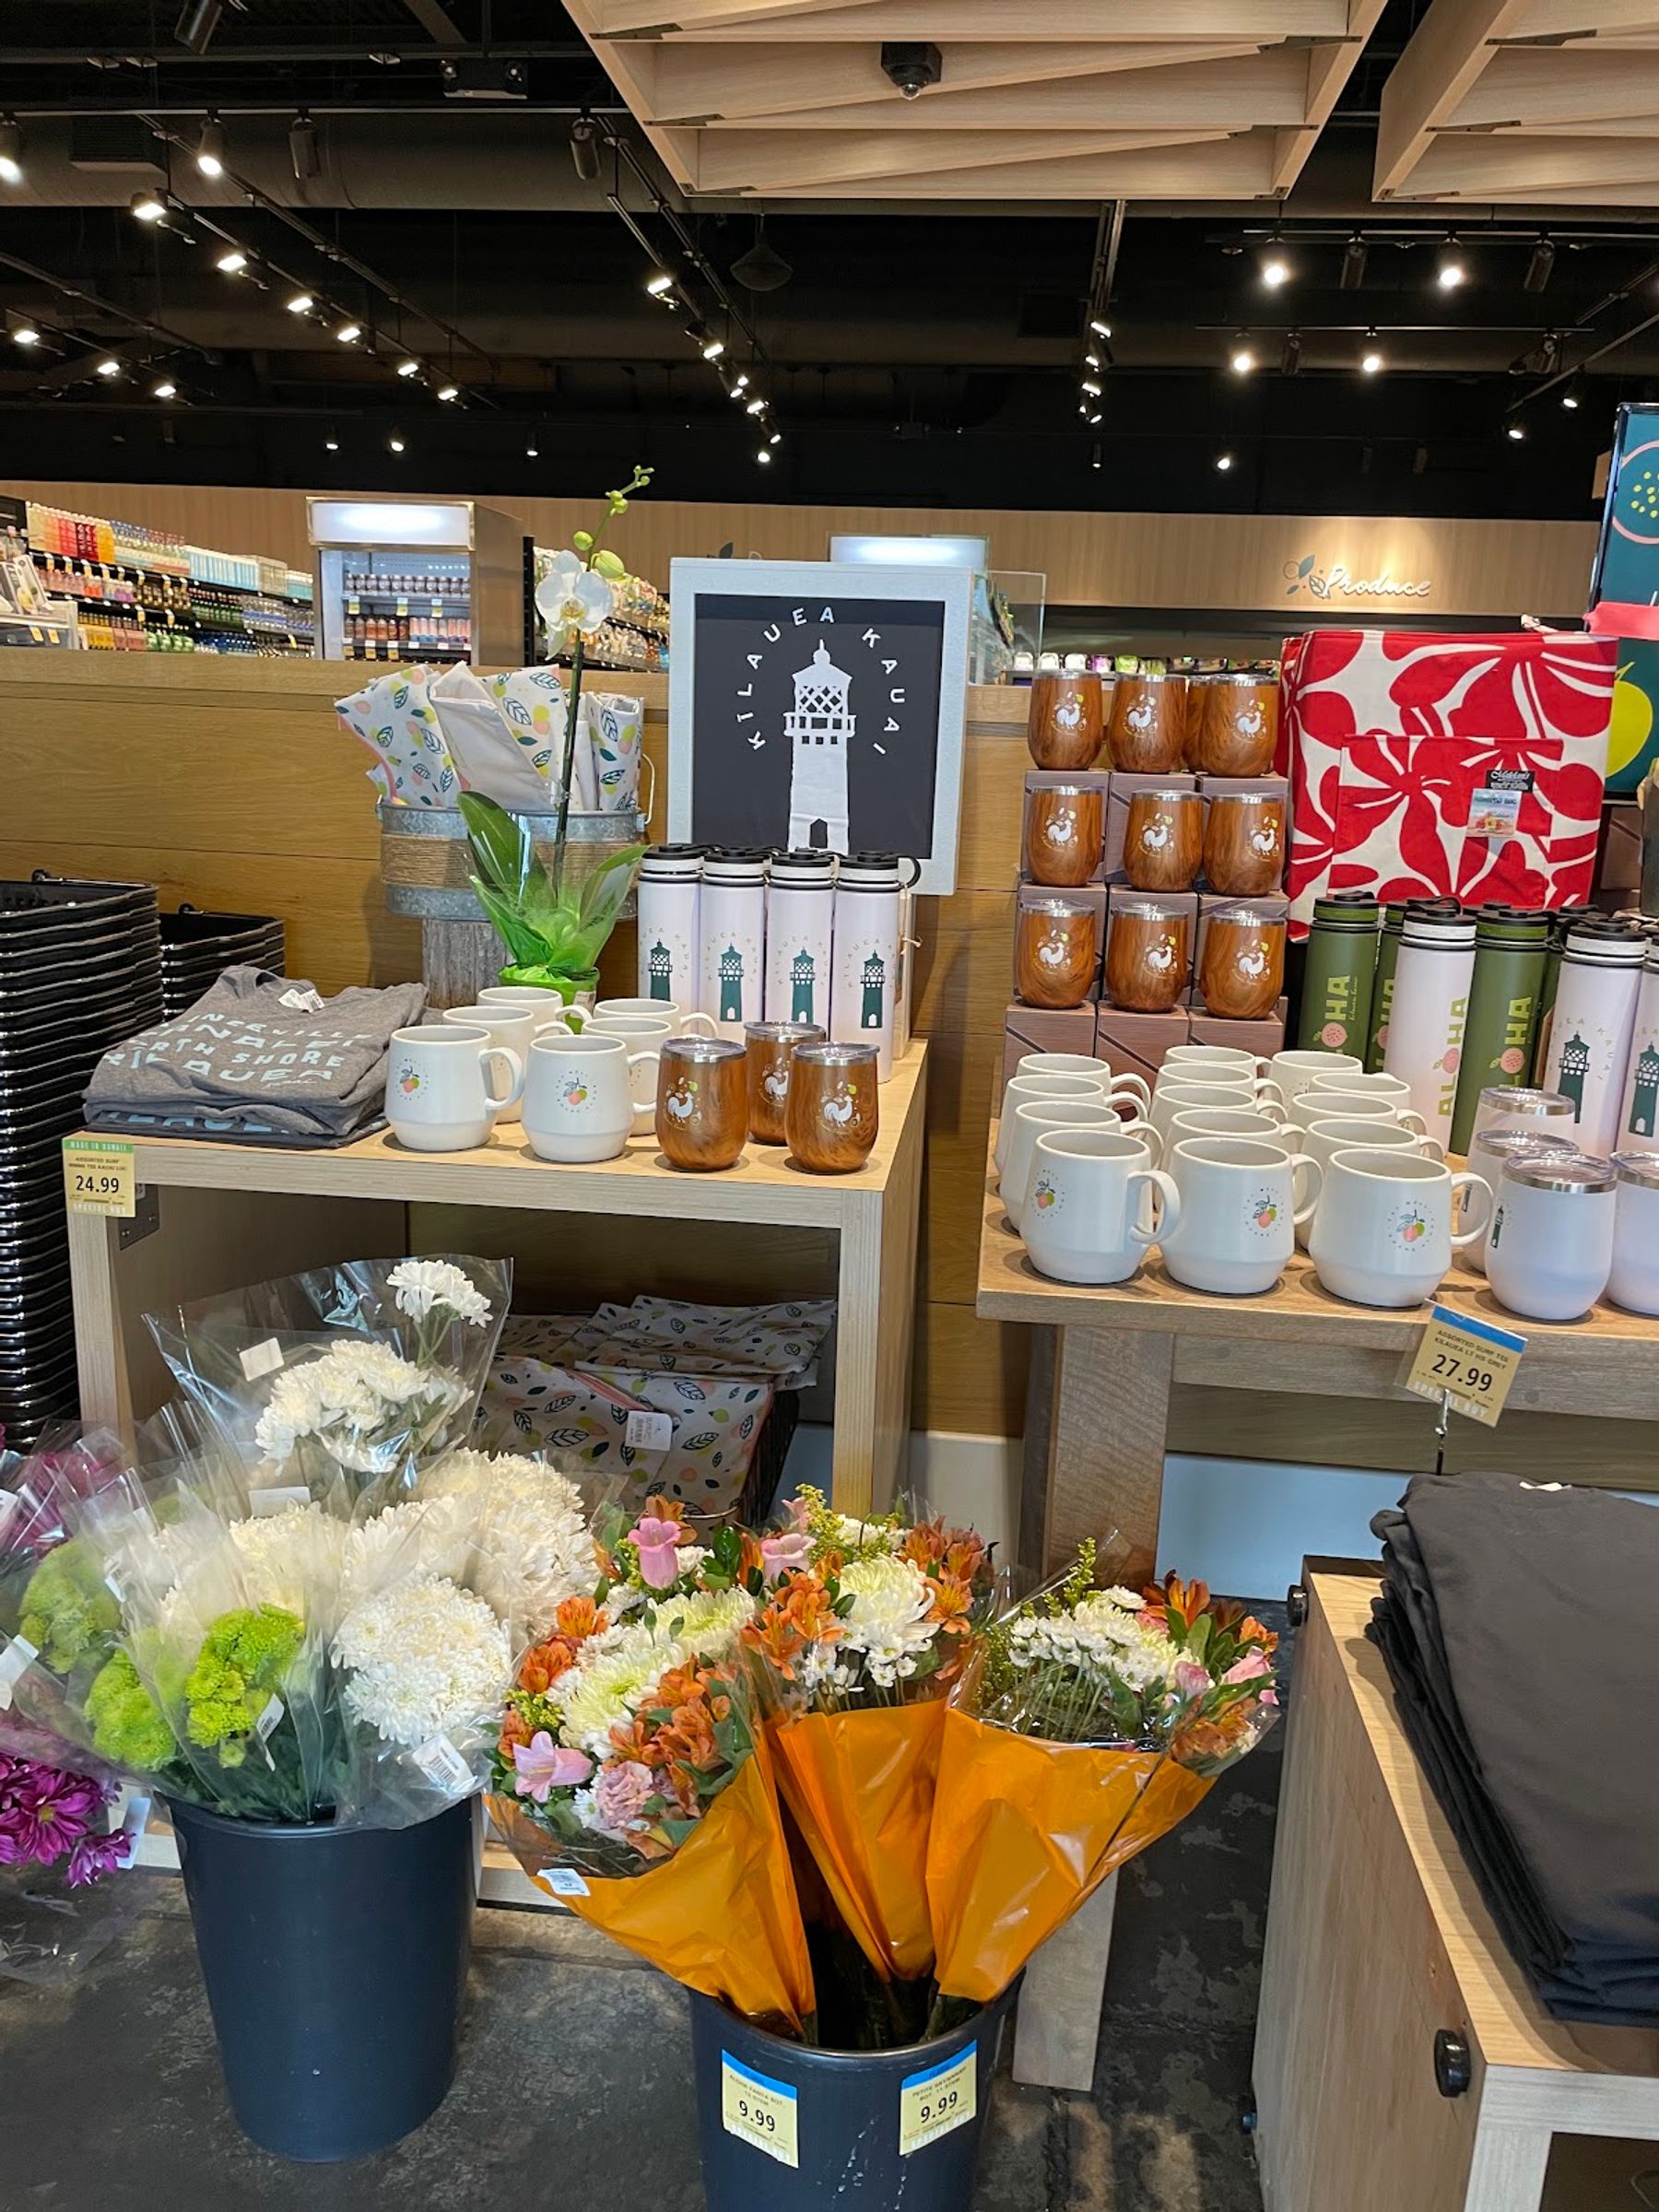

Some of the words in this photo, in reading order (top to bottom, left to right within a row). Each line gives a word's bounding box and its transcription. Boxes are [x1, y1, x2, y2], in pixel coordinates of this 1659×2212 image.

[1323, 563, 1431, 599] Produce
[736, 606, 835, 751] KILAUEA
[861, 628, 906, 756] KAUAI
[102, 1052, 334, 1082] KILAUEA
[231, 1050, 346, 1068] SHORE
[75, 1174, 120, 1194] 24.99
[1438, 1329, 1476, 1348] ASSORTED
[1431, 1353, 1493, 1392] 27.99
[1414, 1380, 1459, 1407] SPECAL
[738, 2100, 776, 2133] 9.99
[920, 2090, 959, 2124] 9.99
